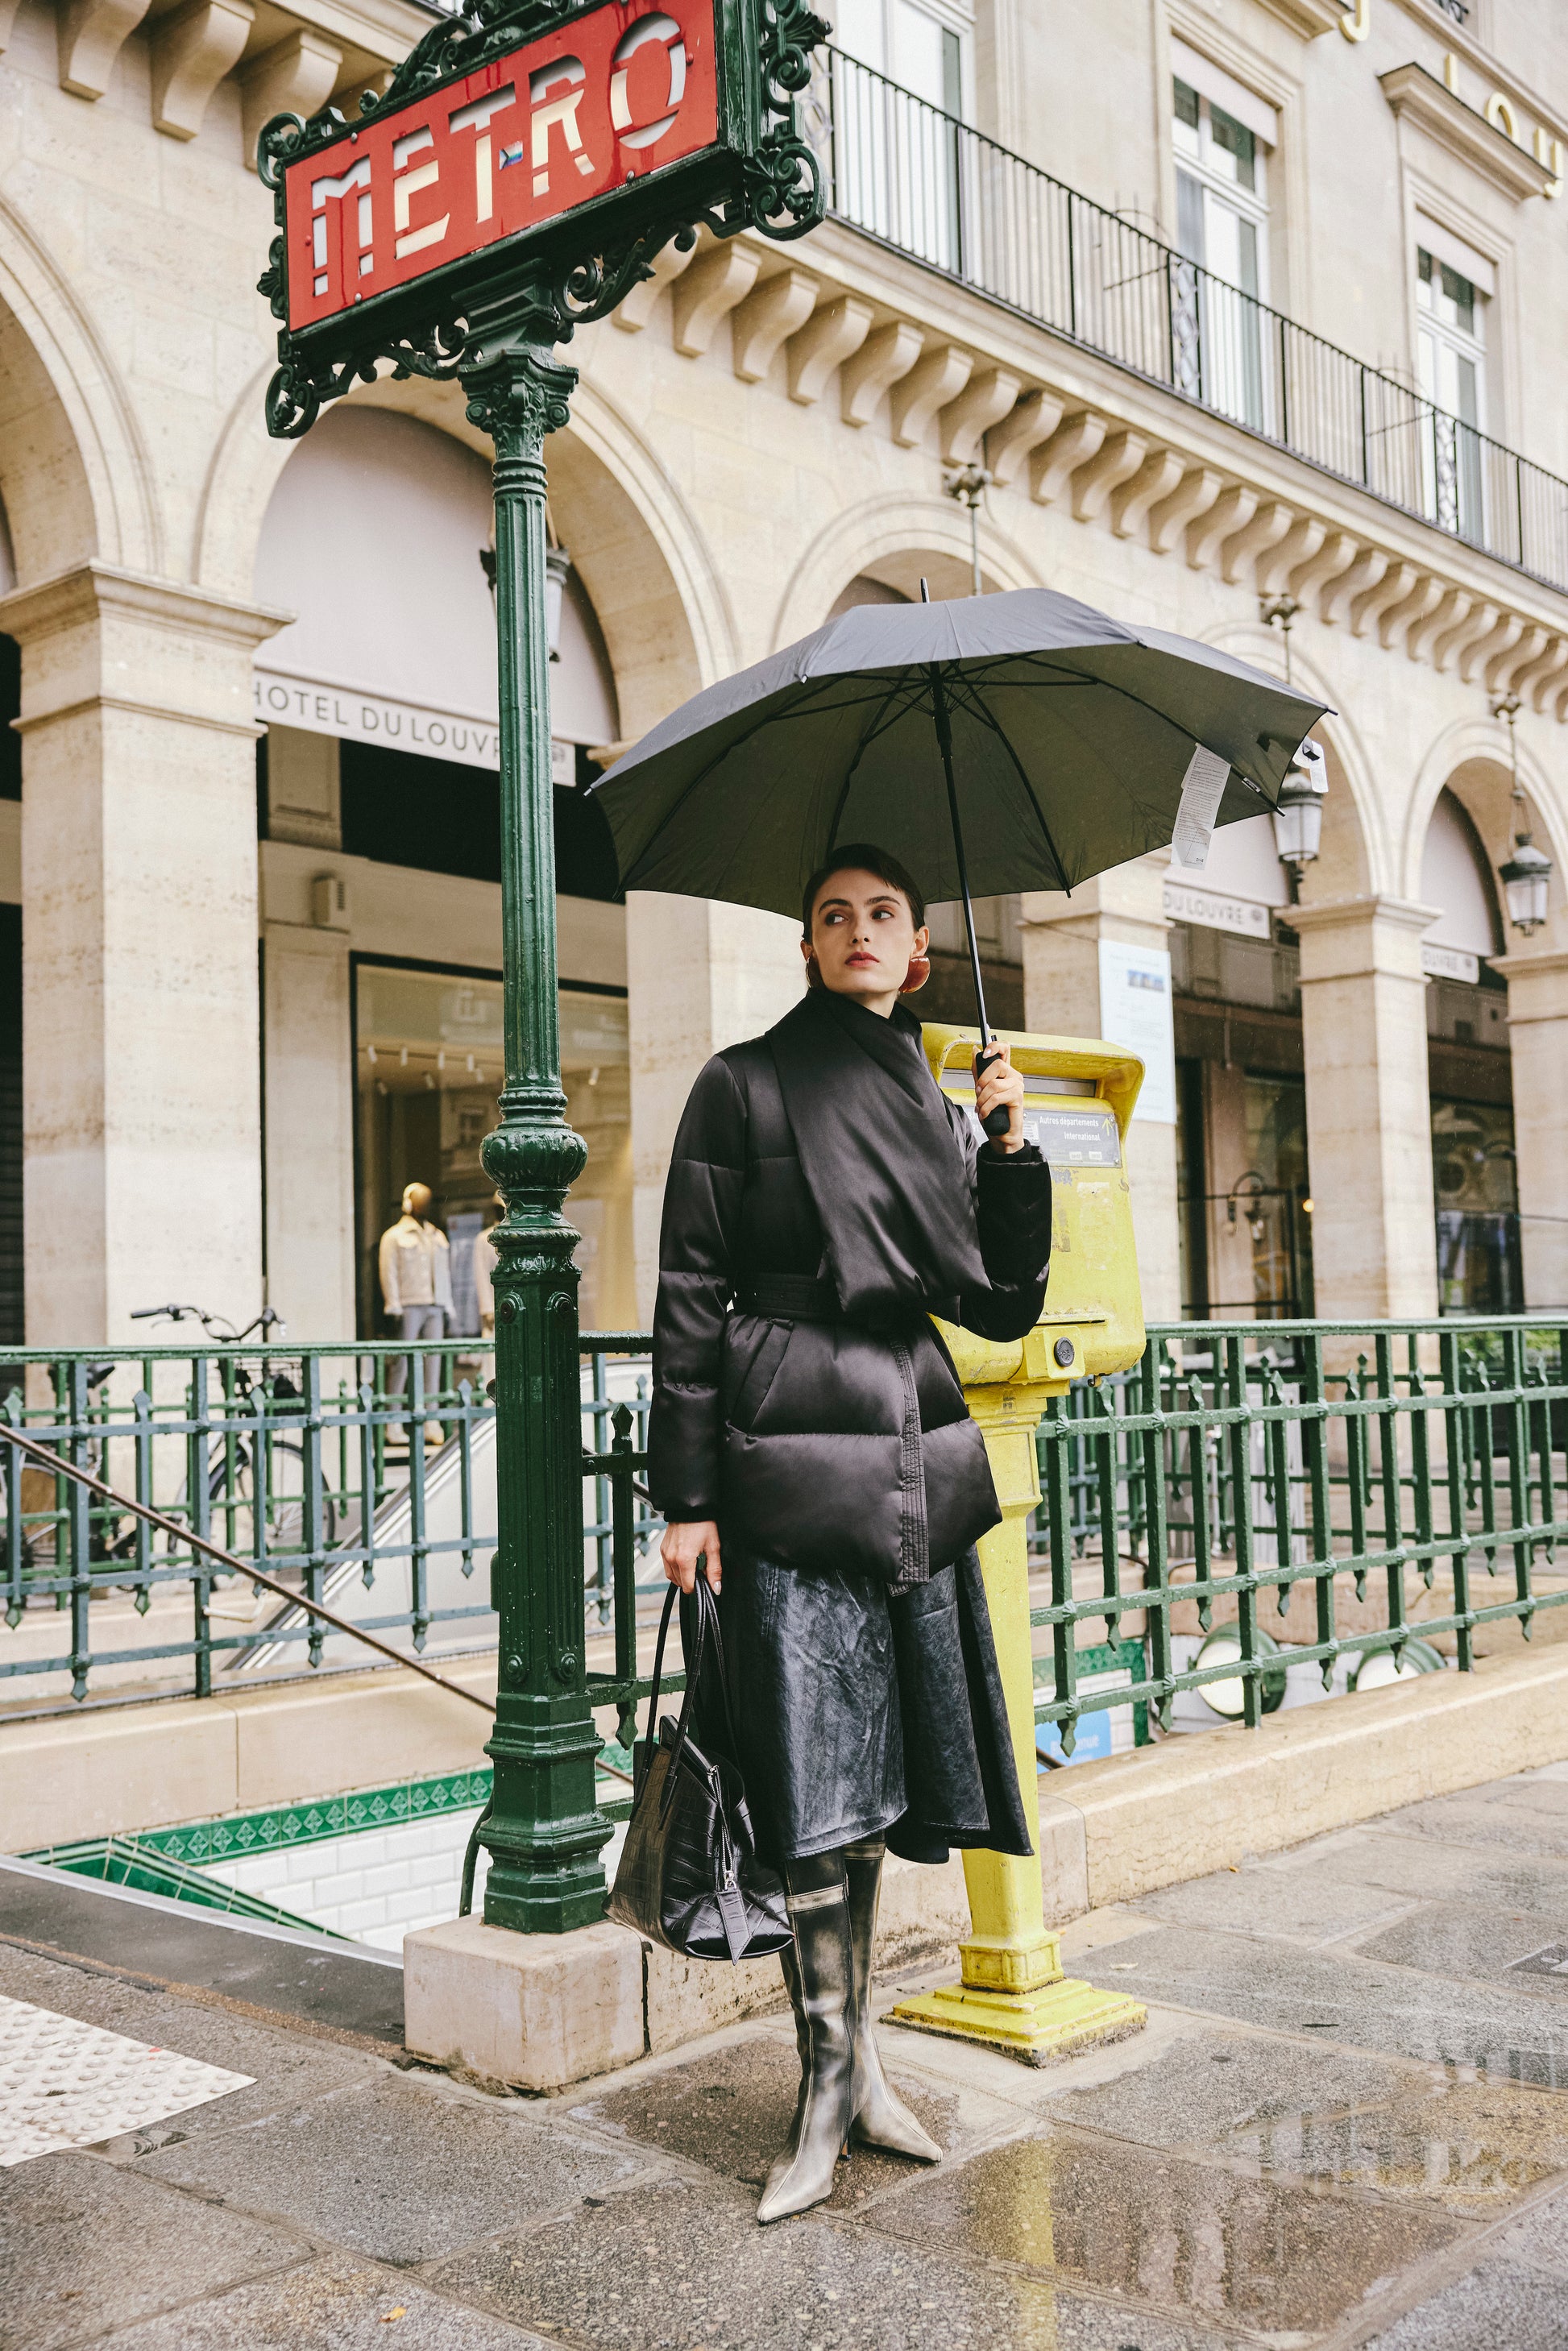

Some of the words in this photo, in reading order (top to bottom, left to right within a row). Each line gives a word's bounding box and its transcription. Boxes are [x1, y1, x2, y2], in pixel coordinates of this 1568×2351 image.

[312, 11, 687, 297] METRO
[362, 707, 401, 736] DU
[1039, 1116, 1060, 1125] Autres
[1060, 1117, 1099, 1127] départements
[1064, 1131, 1101, 1141] International
